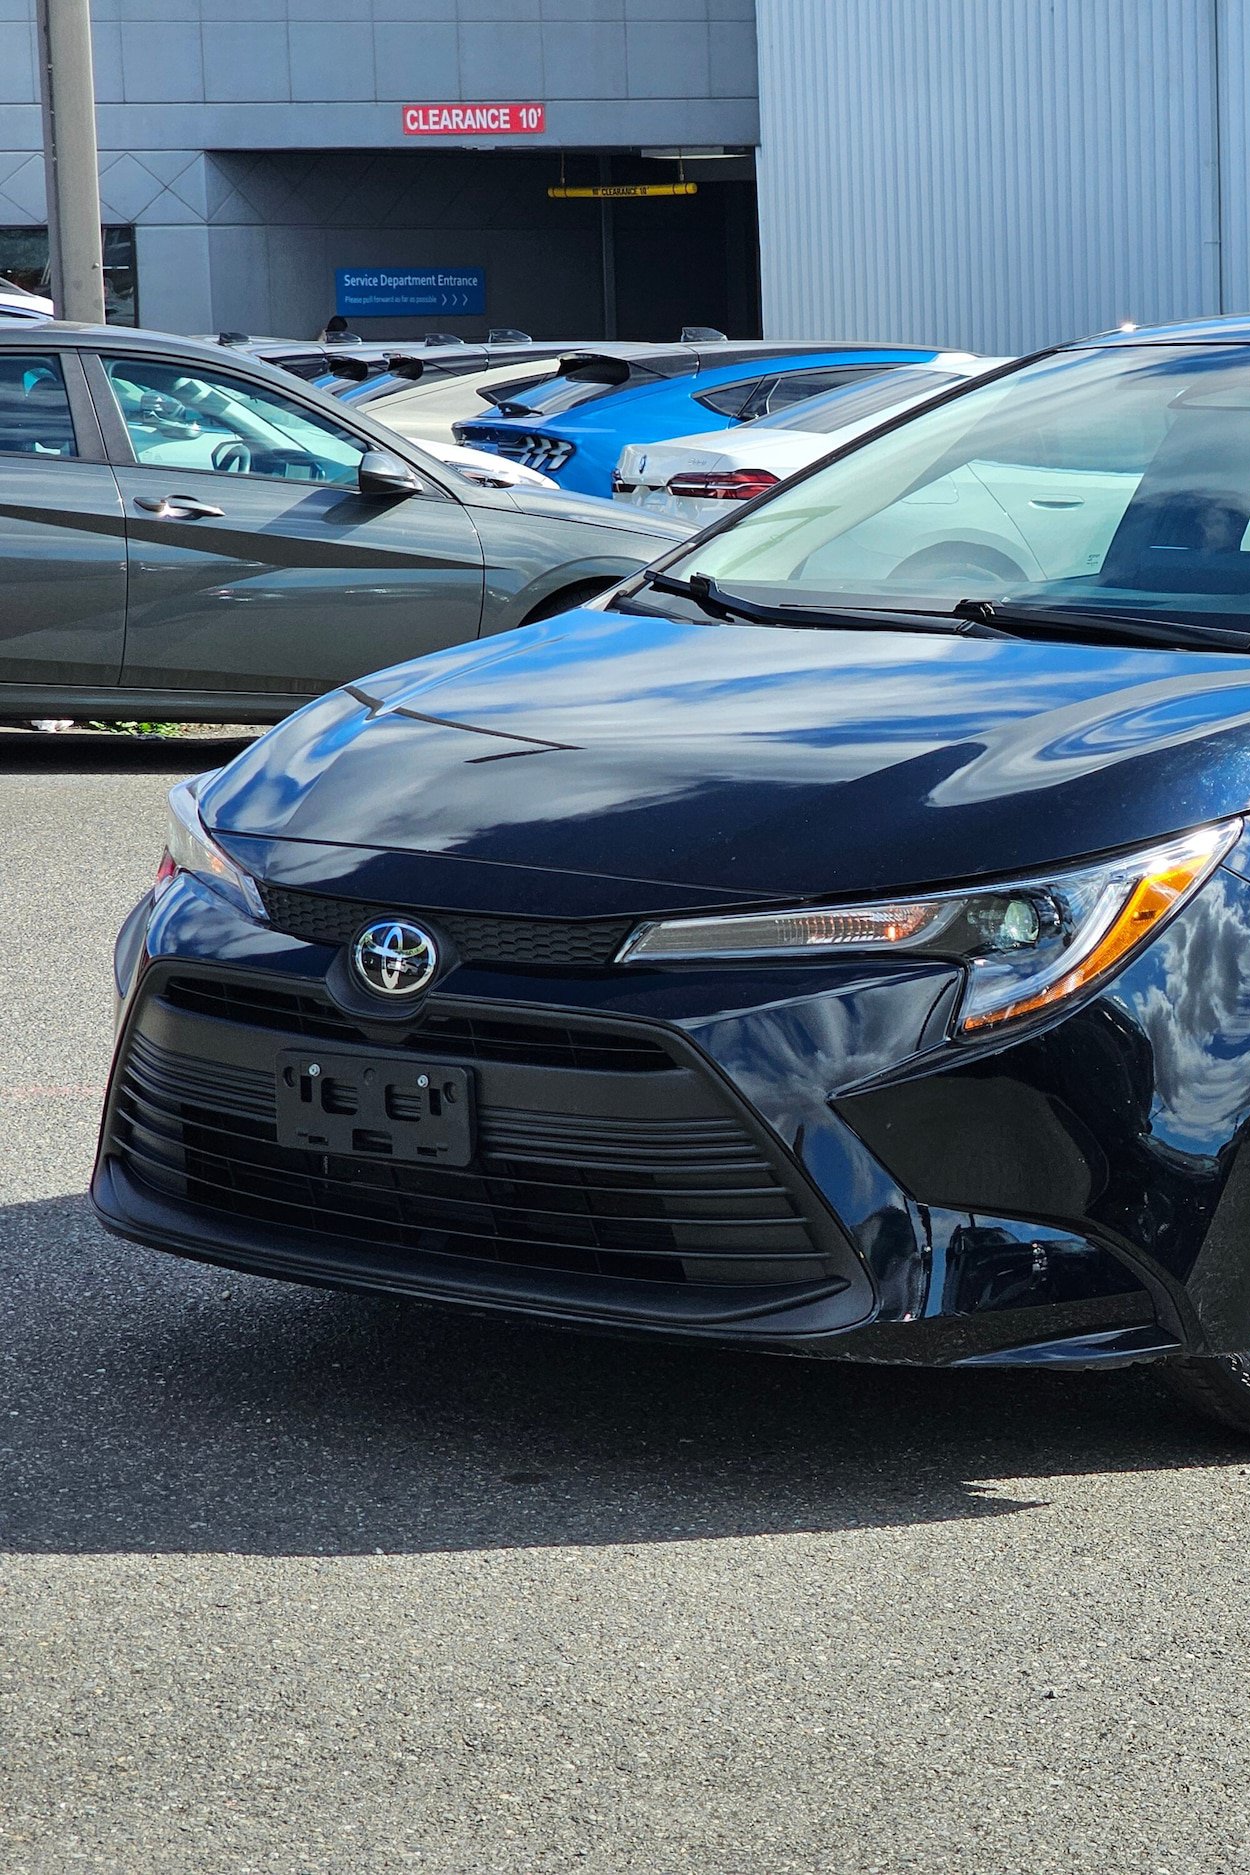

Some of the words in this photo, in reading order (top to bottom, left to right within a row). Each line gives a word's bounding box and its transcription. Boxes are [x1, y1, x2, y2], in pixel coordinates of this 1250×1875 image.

[406, 109, 510, 130] CLEARANCE
[519, 108, 541, 129] 10'
[601, 187, 637, 196] CLEARANCE
[344, 273, 379, 287] Service
[380, 274, 437, 289] Department
[437, 275, 478, 287] Entrance
